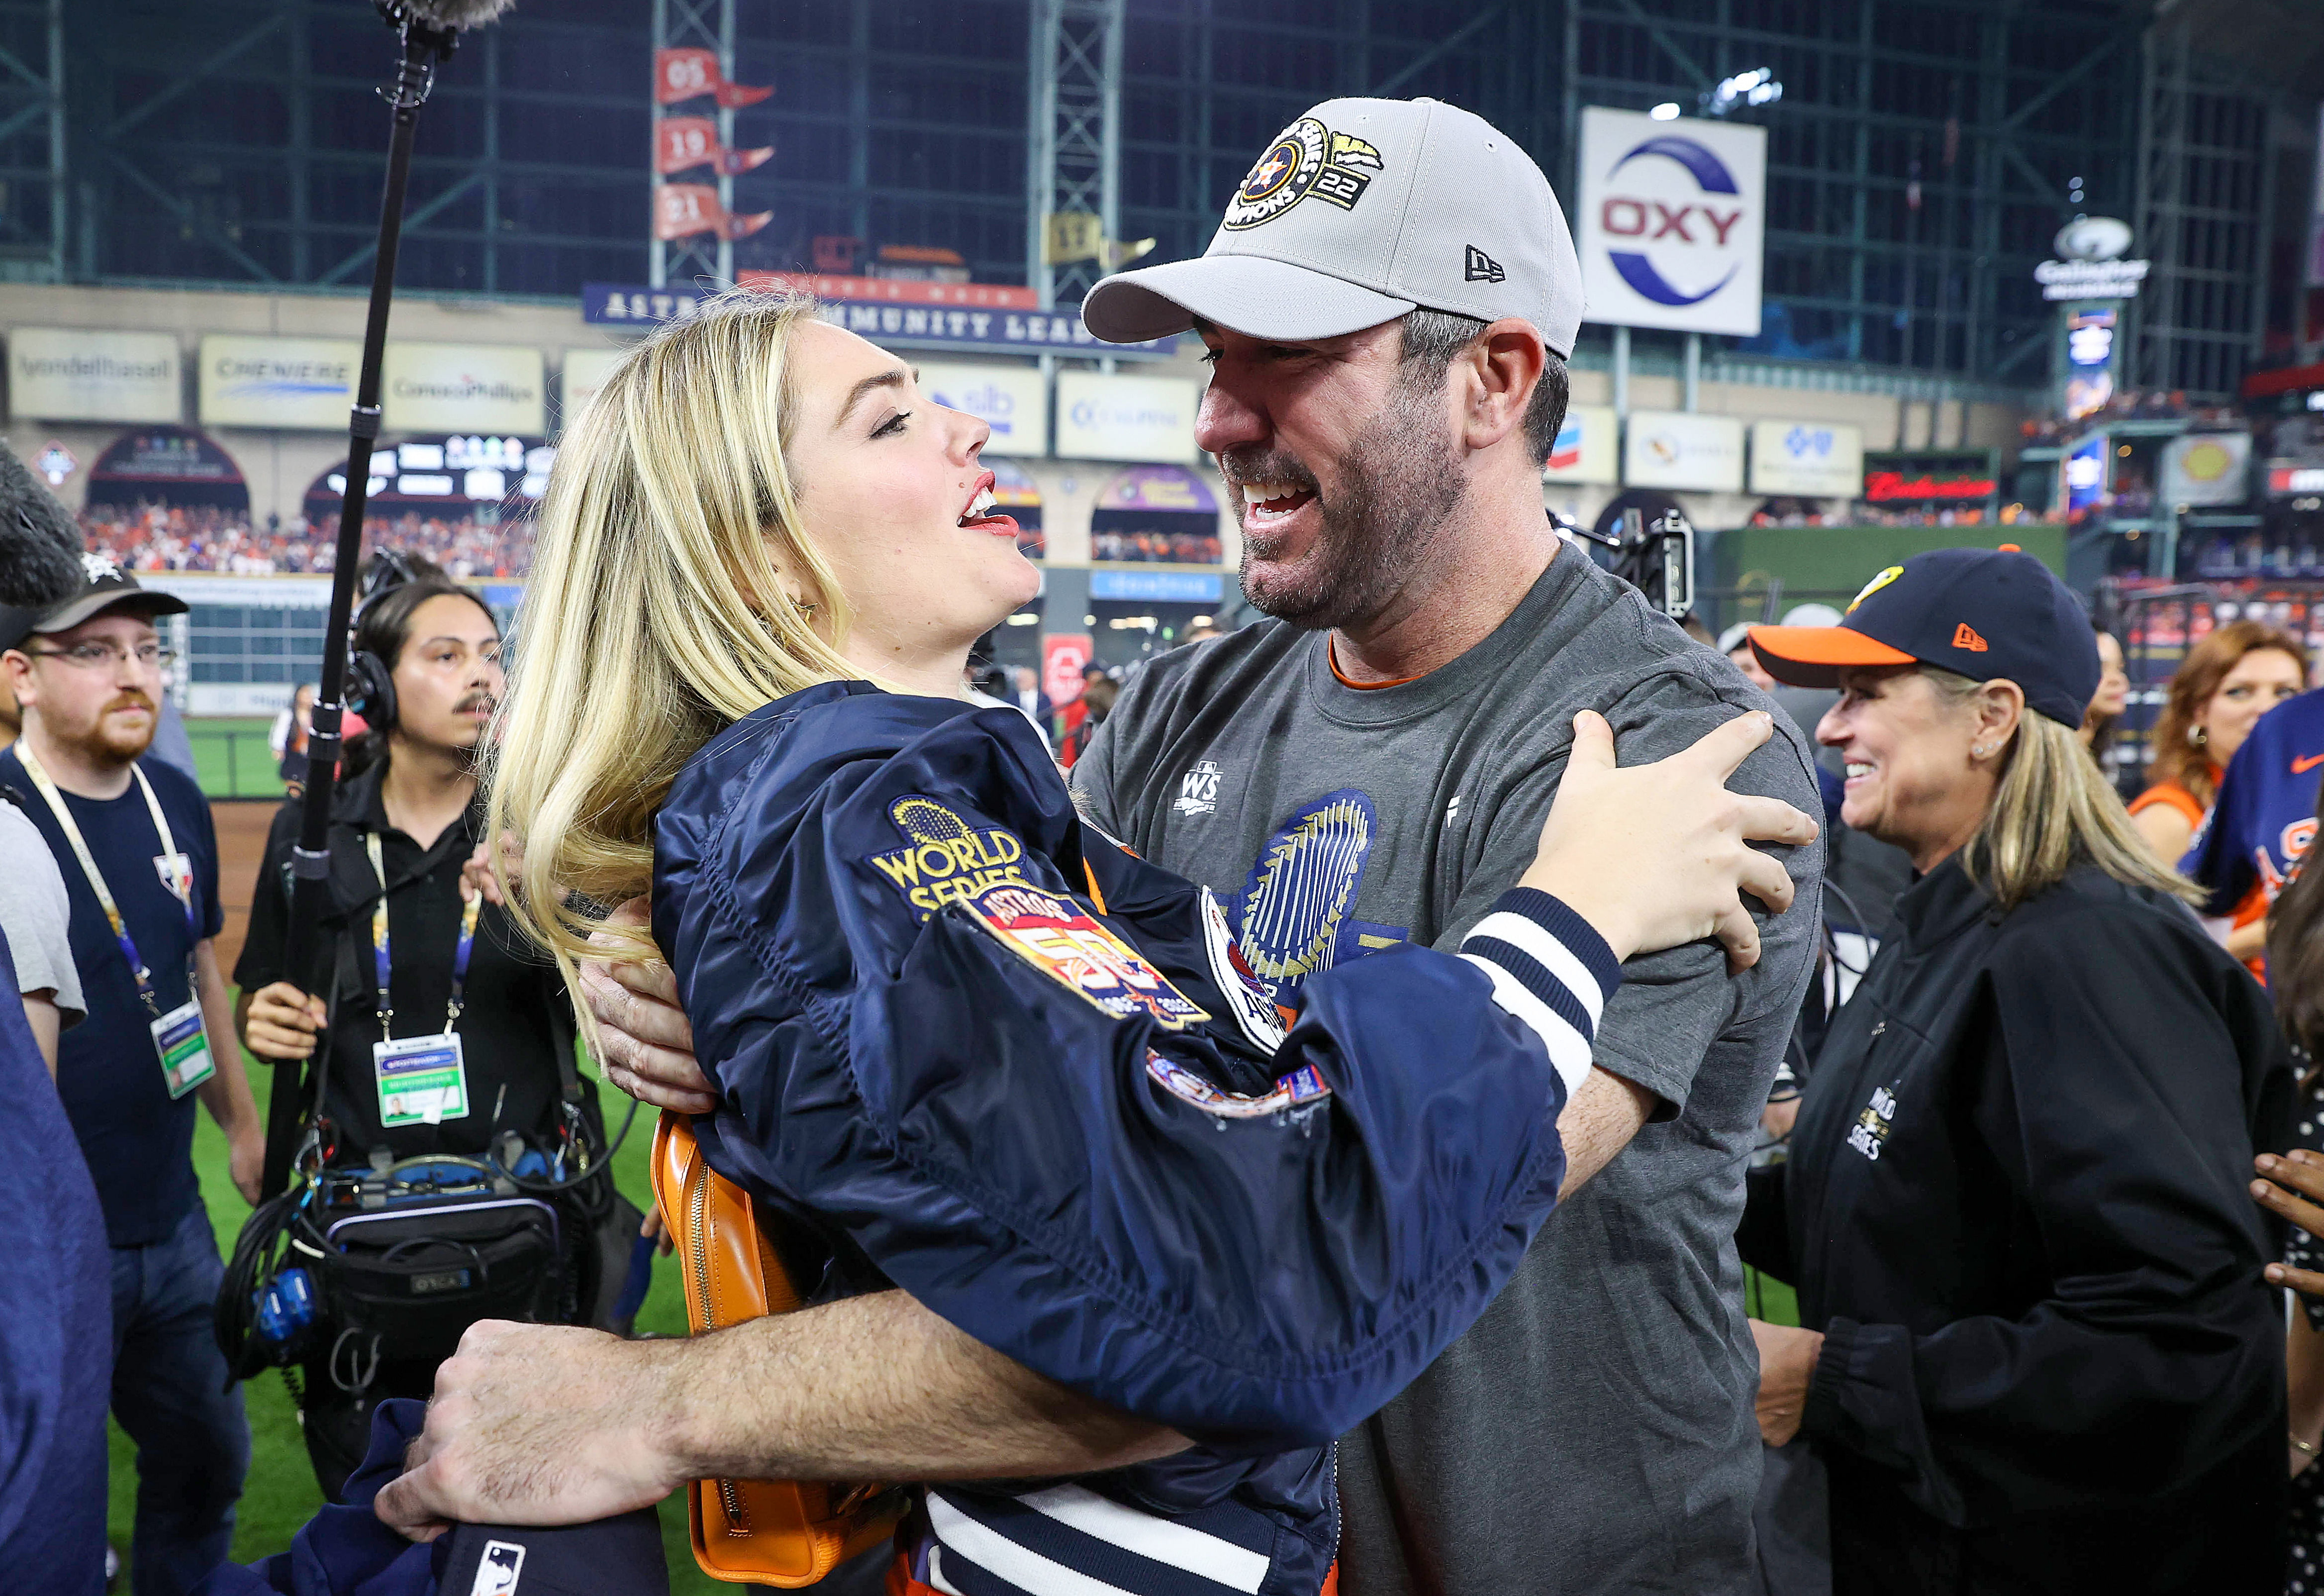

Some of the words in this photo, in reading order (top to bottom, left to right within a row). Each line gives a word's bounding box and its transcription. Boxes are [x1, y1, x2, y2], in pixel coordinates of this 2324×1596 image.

[1317, 172, 1359, 200] 22
[1602, 197, 1740, 246] OXY
[1005, 314, 1159, 349] LEAD
[872, 830, 1021, 889] WORLD
[982, 888, 1073, 925] ASTROS
